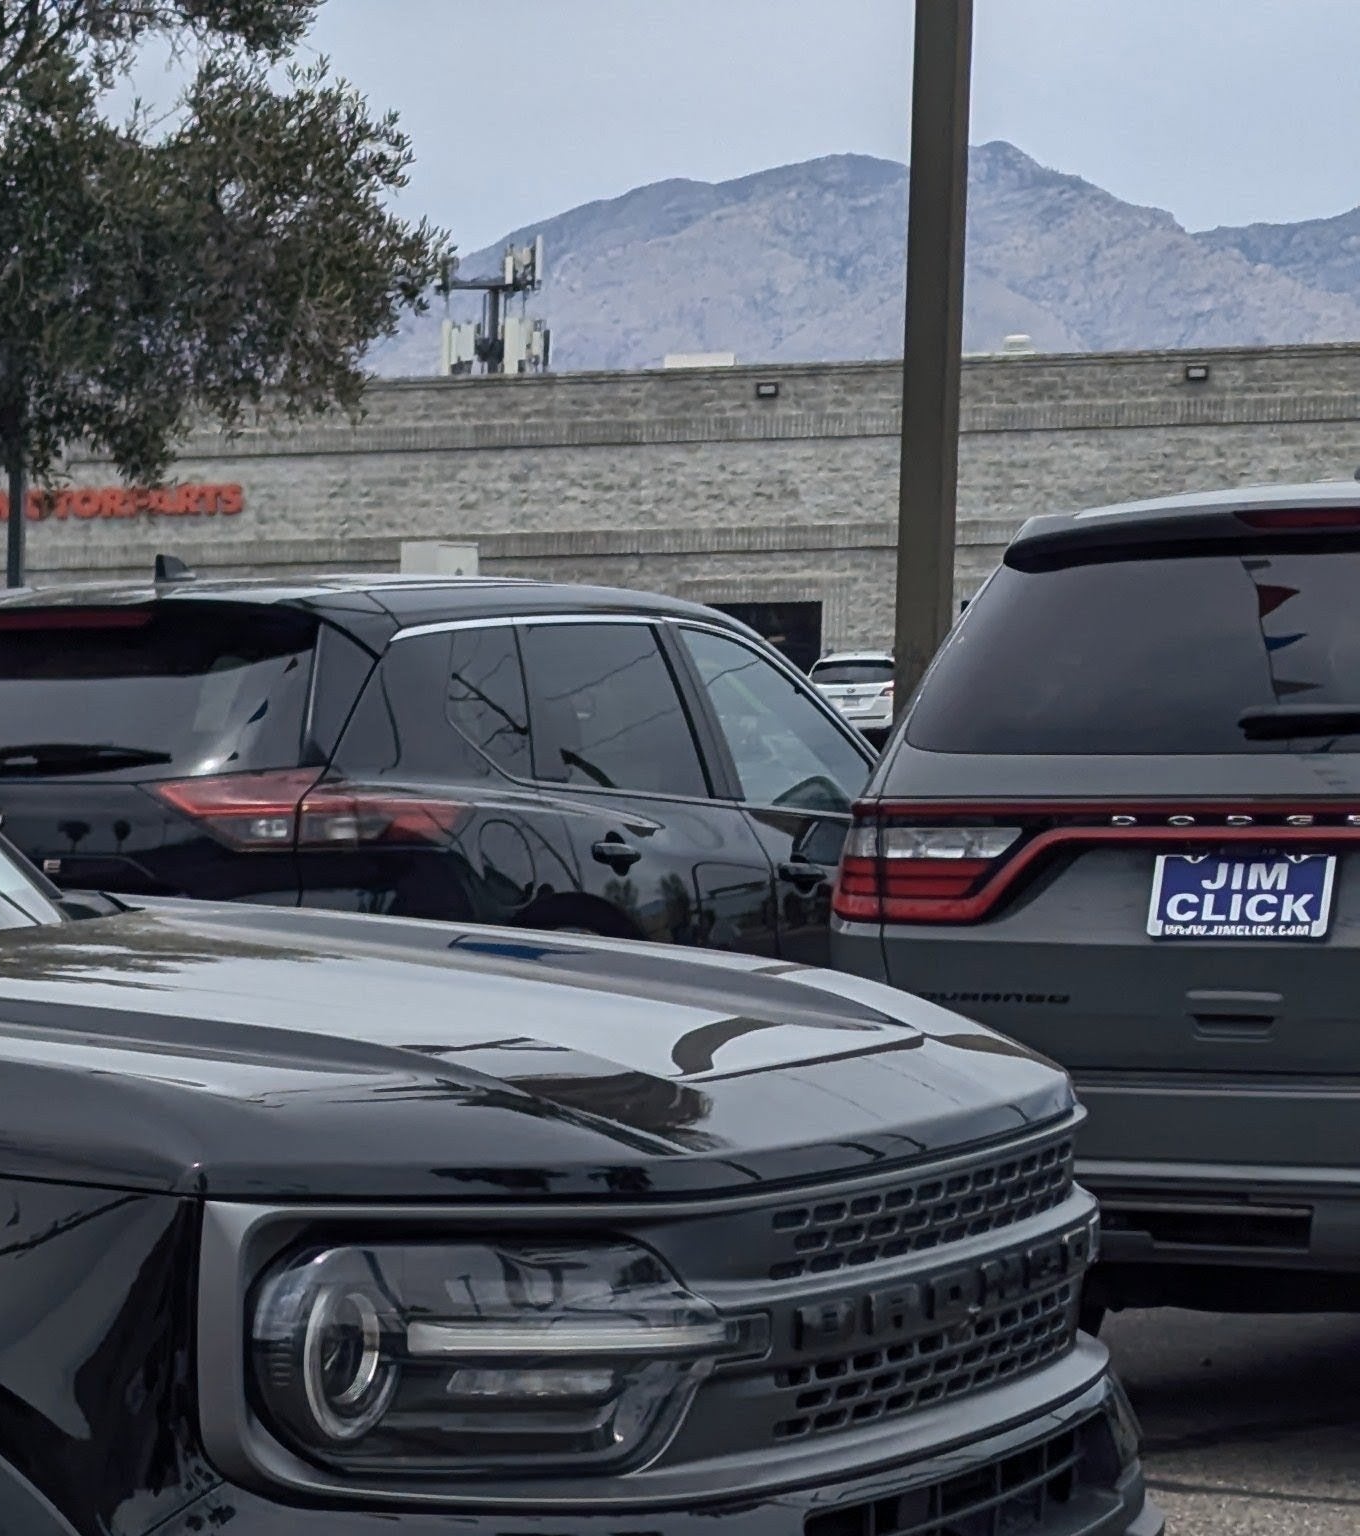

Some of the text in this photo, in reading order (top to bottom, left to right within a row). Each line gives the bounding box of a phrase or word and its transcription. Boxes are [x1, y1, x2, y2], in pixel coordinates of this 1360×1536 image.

[1200, 862, 1290, 891] JIM
[1165, 892, 1315, 922] CLICK
[1164, 923, 1311, 937] WWW.JIMCLICK.COM
